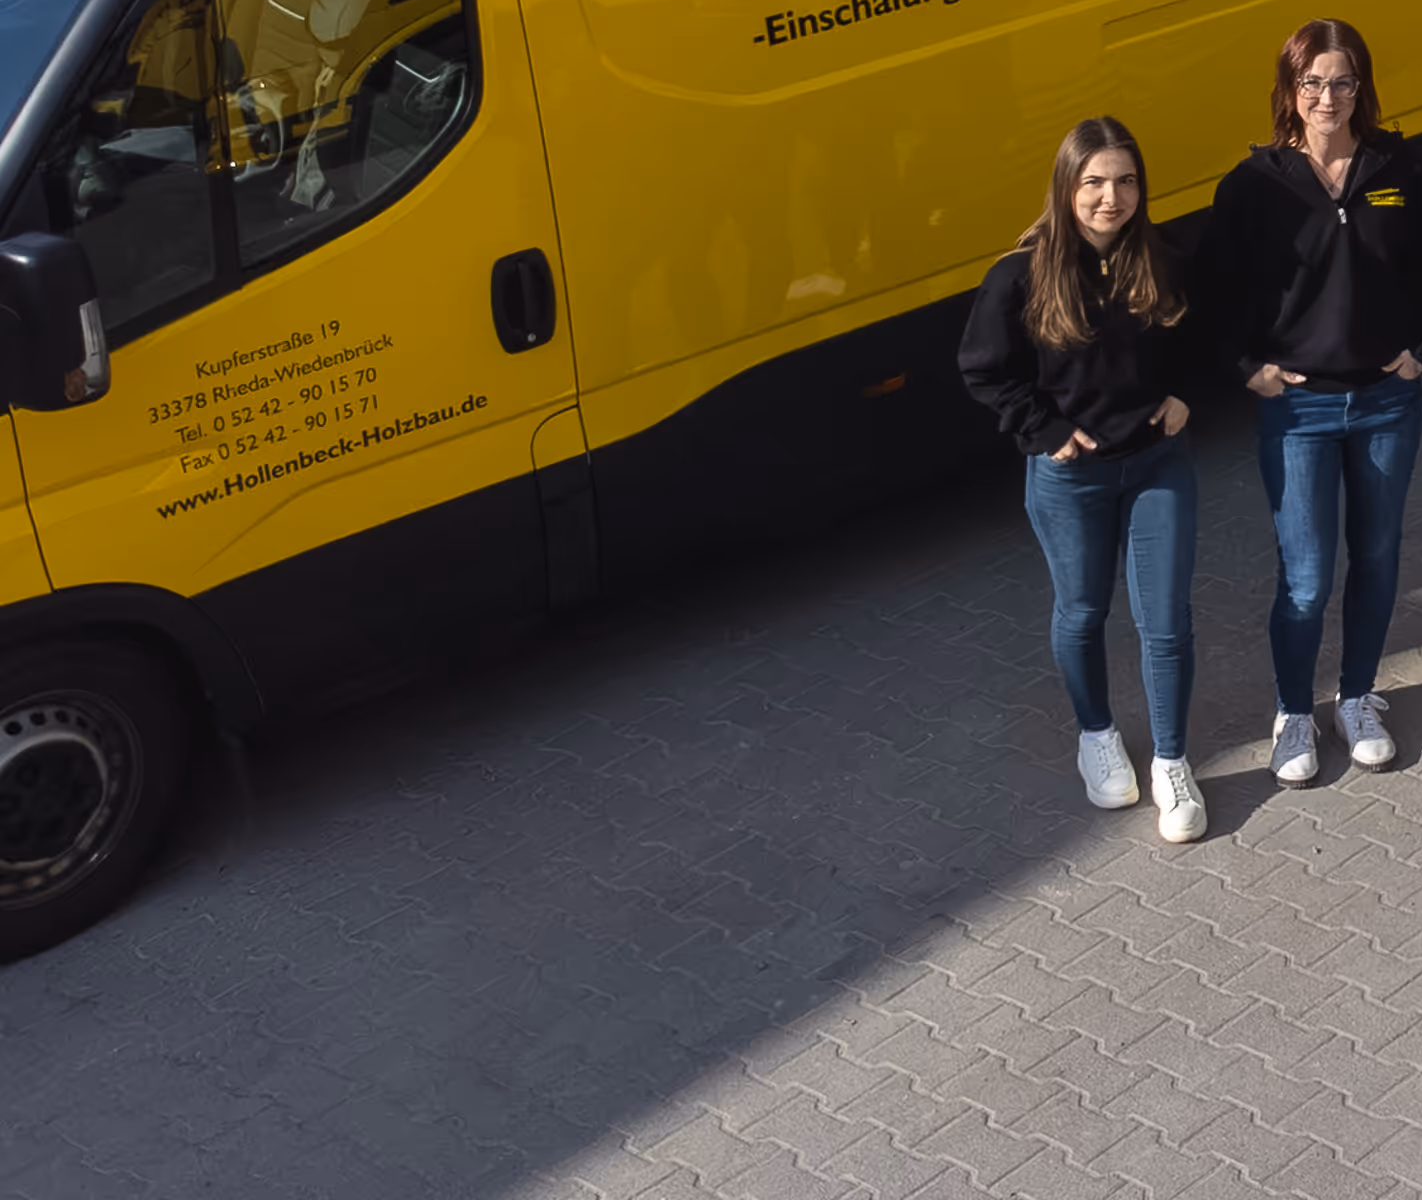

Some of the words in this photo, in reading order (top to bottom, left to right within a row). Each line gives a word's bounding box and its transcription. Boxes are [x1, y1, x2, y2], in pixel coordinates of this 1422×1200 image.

[147, 391, 208, 425] 33378
[211, 333, 394, 404] Rheda-Wiedenbrück
[195, 331, 315, 380] Kupferstraße
[320, 319, 341, 340] 19
[173, 422, 208, 444] Tel.
[213, 415, 226, 433] 0
[230, 406, 256, 428] 52
[258, 397, 283, 417] 42
[299, 383, 323, 404] 90
[329, 374, 350, 395] 15
[354, 367, 377, 387] 70
[179, 453, 215, 474] Fax
[217, 442, 231, 461] 0
[235, 433, 260, 455] 52
[263, 425, 288, 444] 42
[303, 411, 328, 432] 90
[334, 402, 354, 422] 15
[358, 394, 378, 414] 71
[156, 394, 488, 520] www.Hollenbeck-Holzbau.de
